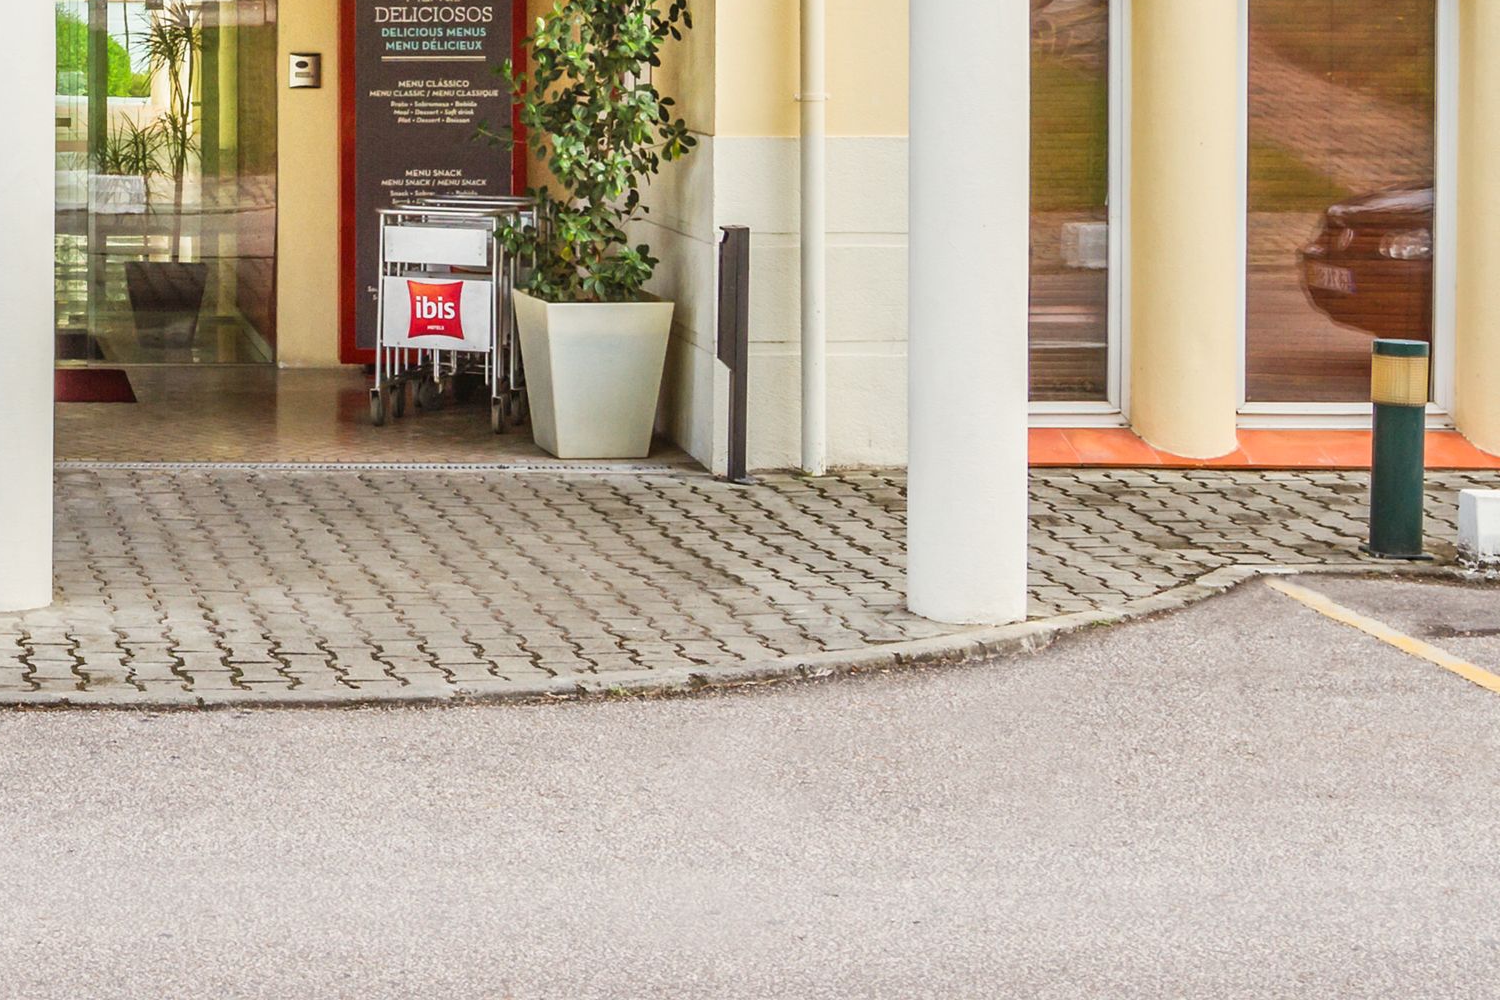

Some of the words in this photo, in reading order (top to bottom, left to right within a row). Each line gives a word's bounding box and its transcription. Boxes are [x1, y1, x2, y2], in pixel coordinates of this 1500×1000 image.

[374, 6, 493, 23] DELICIOSOS
[381, 27, 444, 38] DELICIOUS
[446, 27, 487, 37] MENUS
[385, 41, 419, 51] MENU
[422, 38, 482, 51] DÉLICIEUX
[426, 78, 470, 87] CLÁSSICO
[456, 89, 499, 97] CLASSIQUE
[405, 169, 431, 177] MENU
[432, 169, 462, 177] SNACK
[415, 296, 456, 319] ibis
